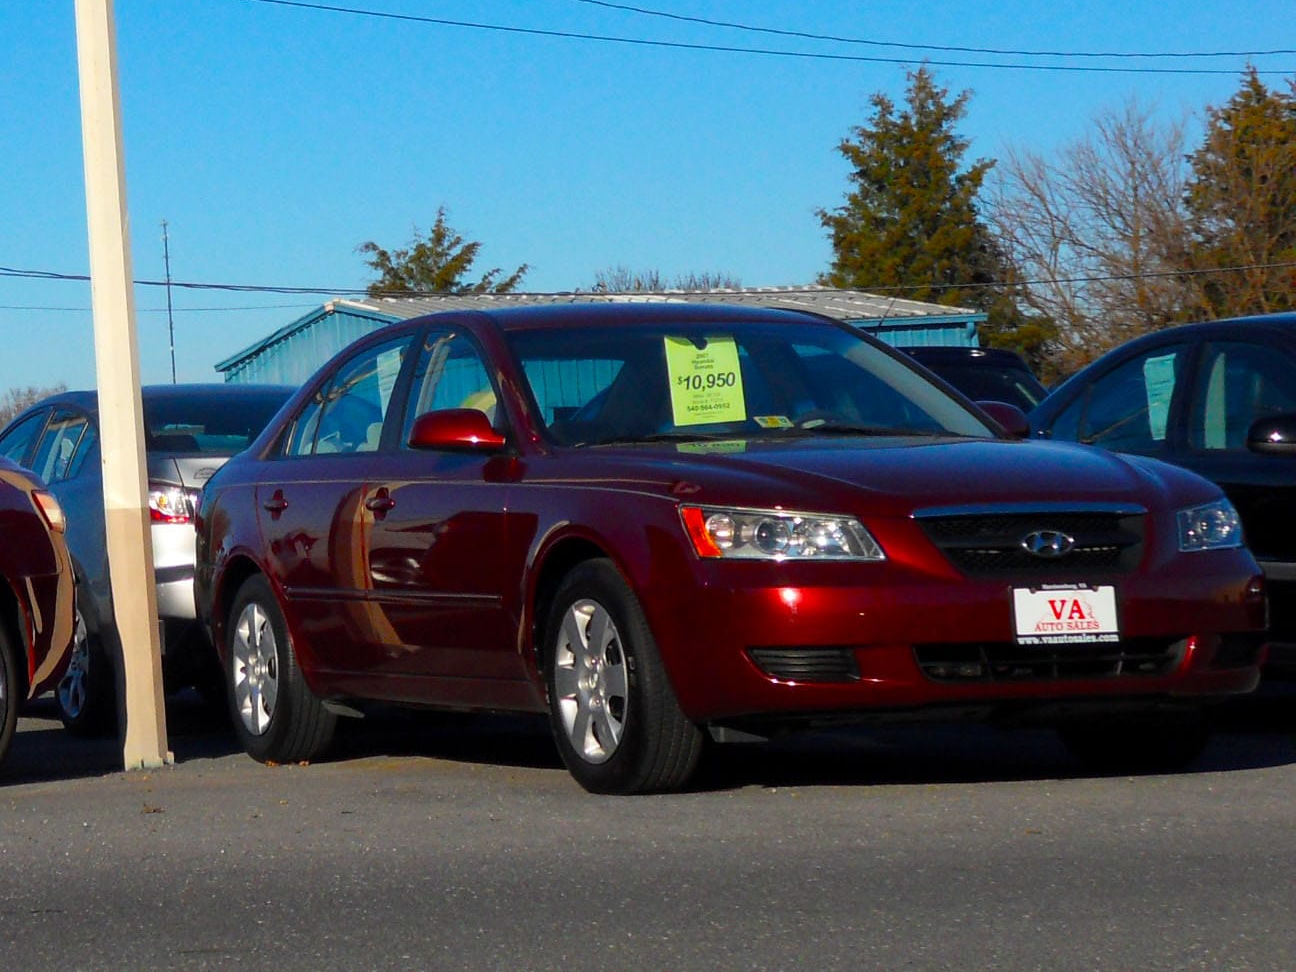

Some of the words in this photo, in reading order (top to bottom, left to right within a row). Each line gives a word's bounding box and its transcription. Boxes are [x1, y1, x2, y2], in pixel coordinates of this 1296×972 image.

[677, 372, 736, 392] $10,950
[1048, 599, 1085, 620] VA
[1035, 622, 1063, 632] AUTO
[1067, 621, 1099, 630] SALES
